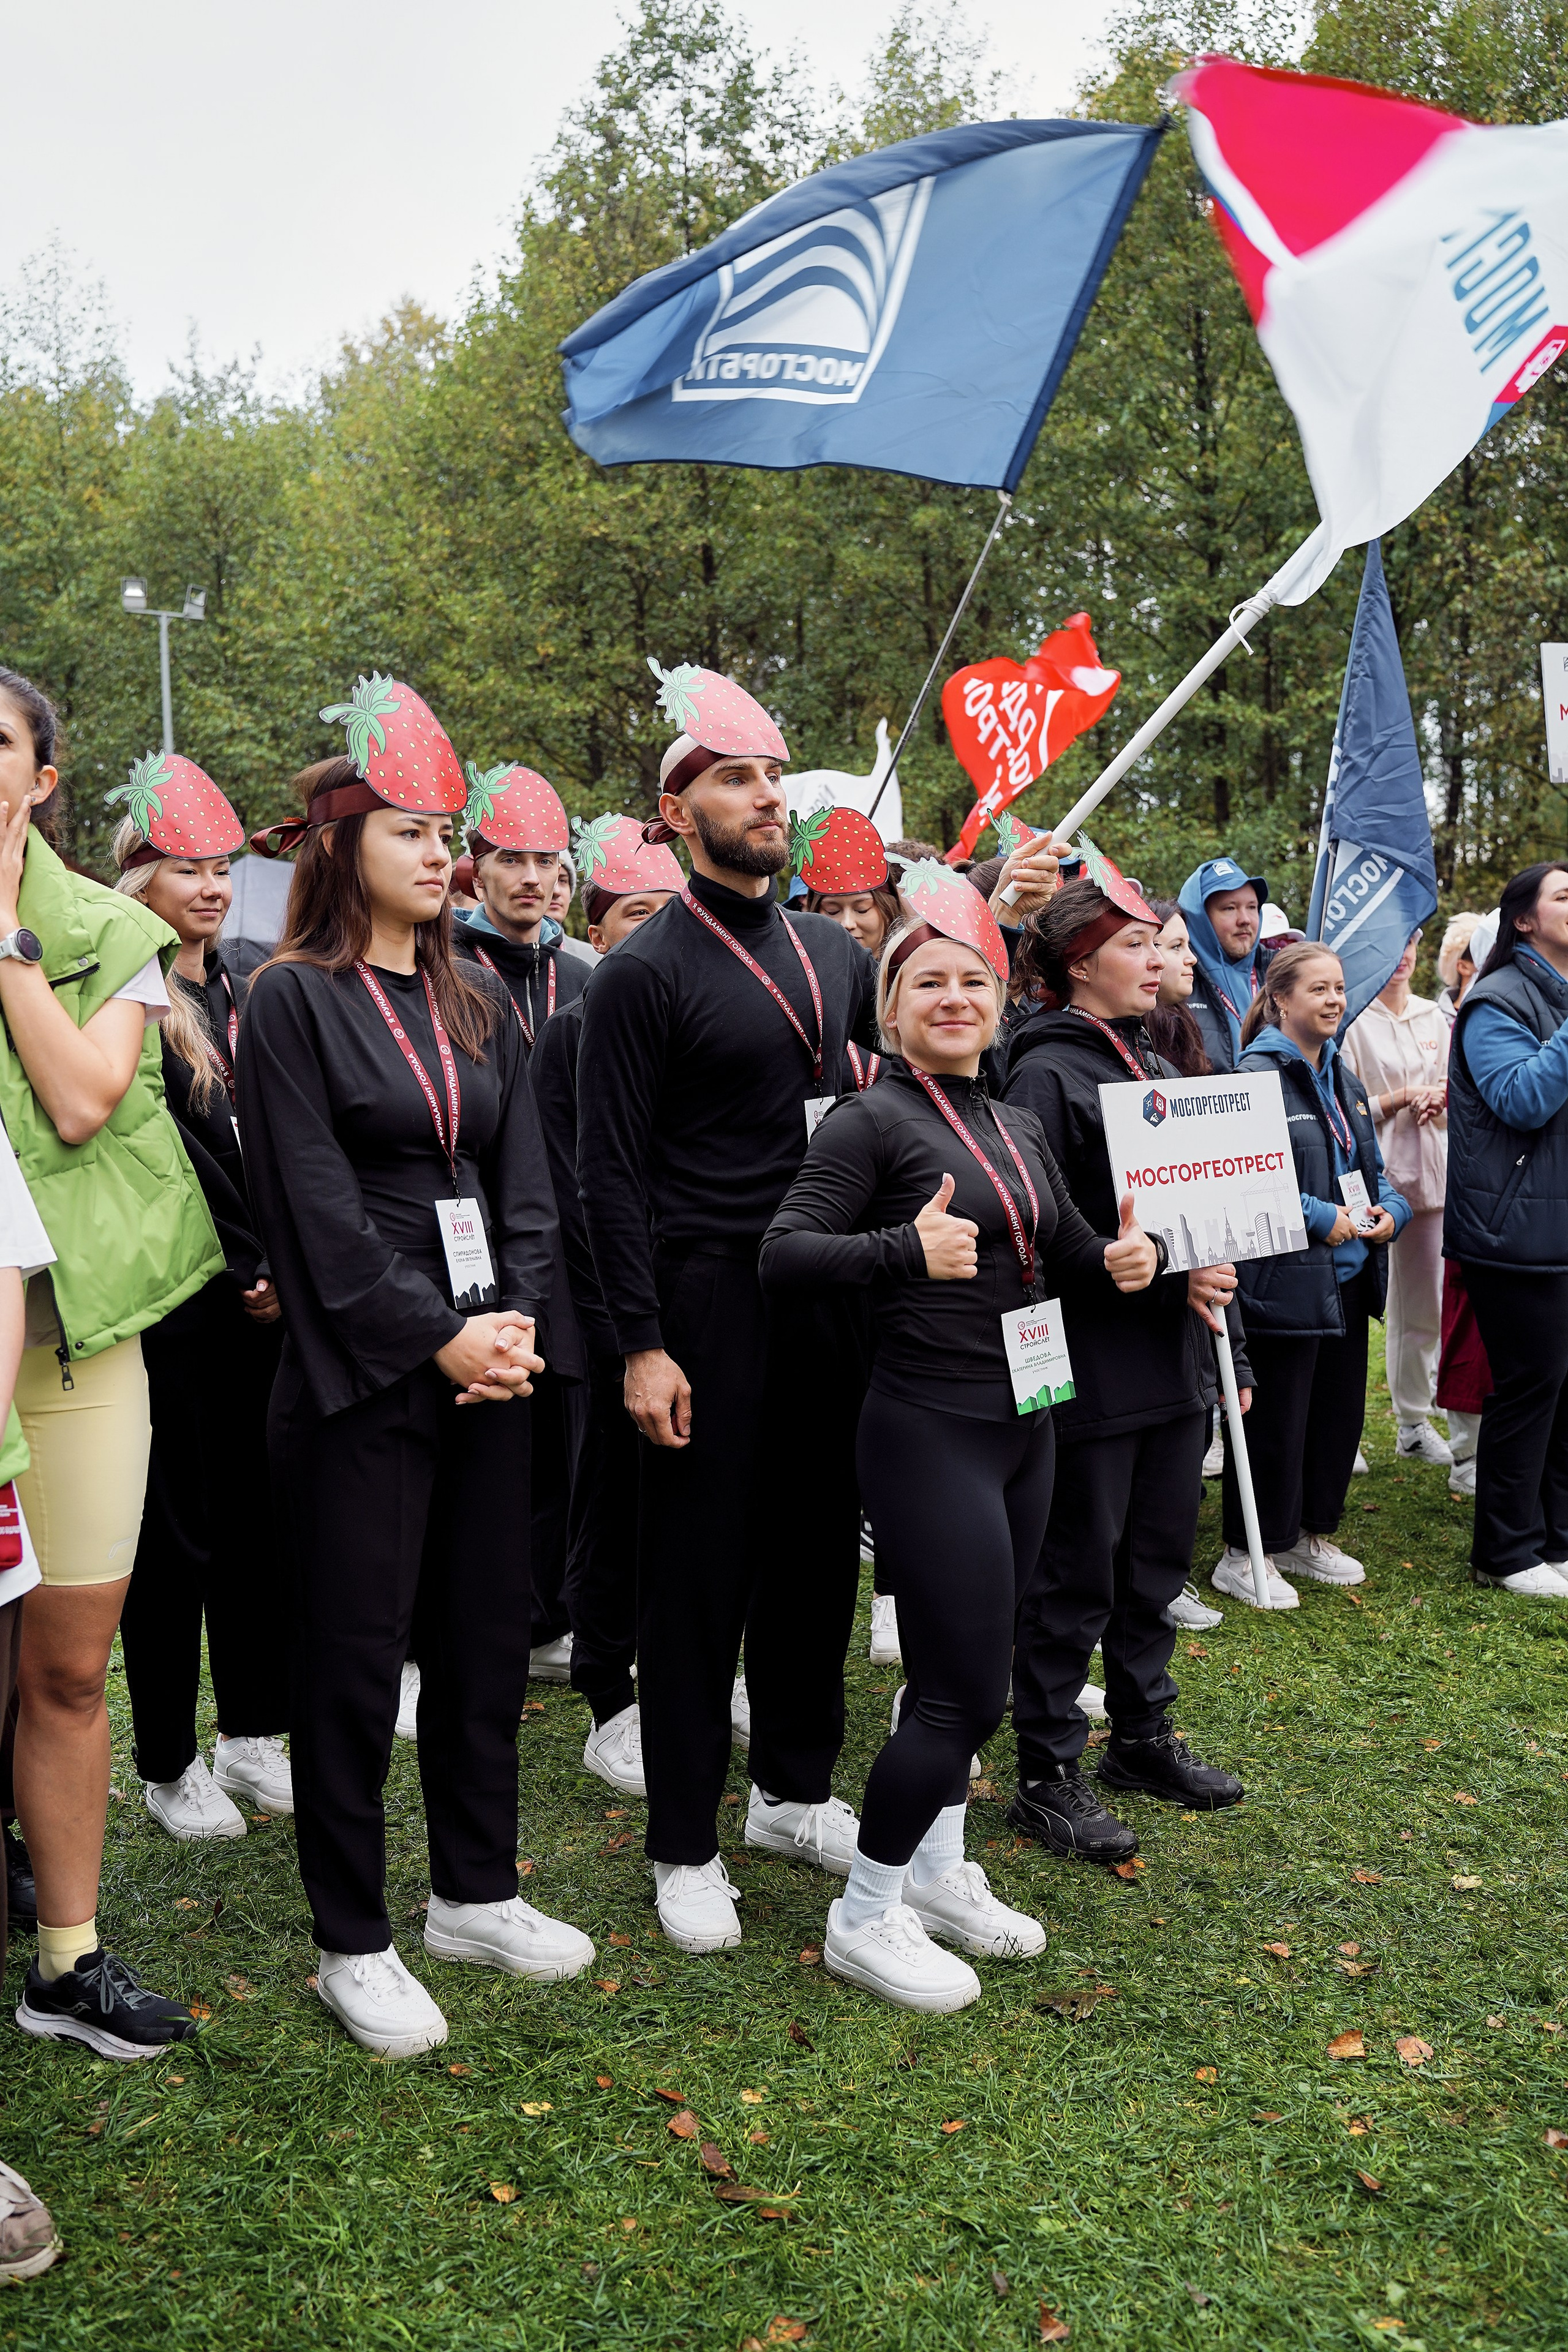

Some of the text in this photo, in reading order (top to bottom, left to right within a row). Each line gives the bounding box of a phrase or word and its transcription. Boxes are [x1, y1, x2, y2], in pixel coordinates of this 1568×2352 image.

[696, 907, 731, 941] ФУНДАМЕНТ
[729, 940, 753, 966] ГОРОДА
[363, 973, 392, 1017] ФУНДАМЕНТ
[807, 968, 819, 996] ГОРОДА
[777, 993, 804, 1033] ФУНДАМЕНТ
[1096, 1019, 1118, 1043] ГОРОДА
[408, 1052, 429, 1085] ГОРОДА
[447, 1066, 458, 1115] ФУНДАМЕНТ
[1169, 1092, 1251, 1118] МОСГОРГЕОТРЕСТ
[424, 1087, 443, 1137] ФУНДАМЕНТ
[927, 1080, 958, 1121] ФУНДАМЕНТ
[954, 1121, 977, 1150] ГОРОДА
[1019, 1164, 1034, 1193] ГОРОДА
[1126, 1152, 1284, 1189] МОСГОРГЕОТРЕСТ
[451, 1221, 473, 1235] XVIII
[997, 1182, 1020, 1230] ФУНДАМЕНТ
[1014, 1231, 1028, 1266] ГОРОДА
[1019, 1324, 1049, 1343] XVIII
[1020, 1336, 1050, 1350] СТРОЙСЛЁТ
[1012, 1354, 1066, 1374] ЕКАТЕРИНА ВЛАДИМИРОВНА
[1025, 1351, 1052, 1363] ШВЕДОВА
